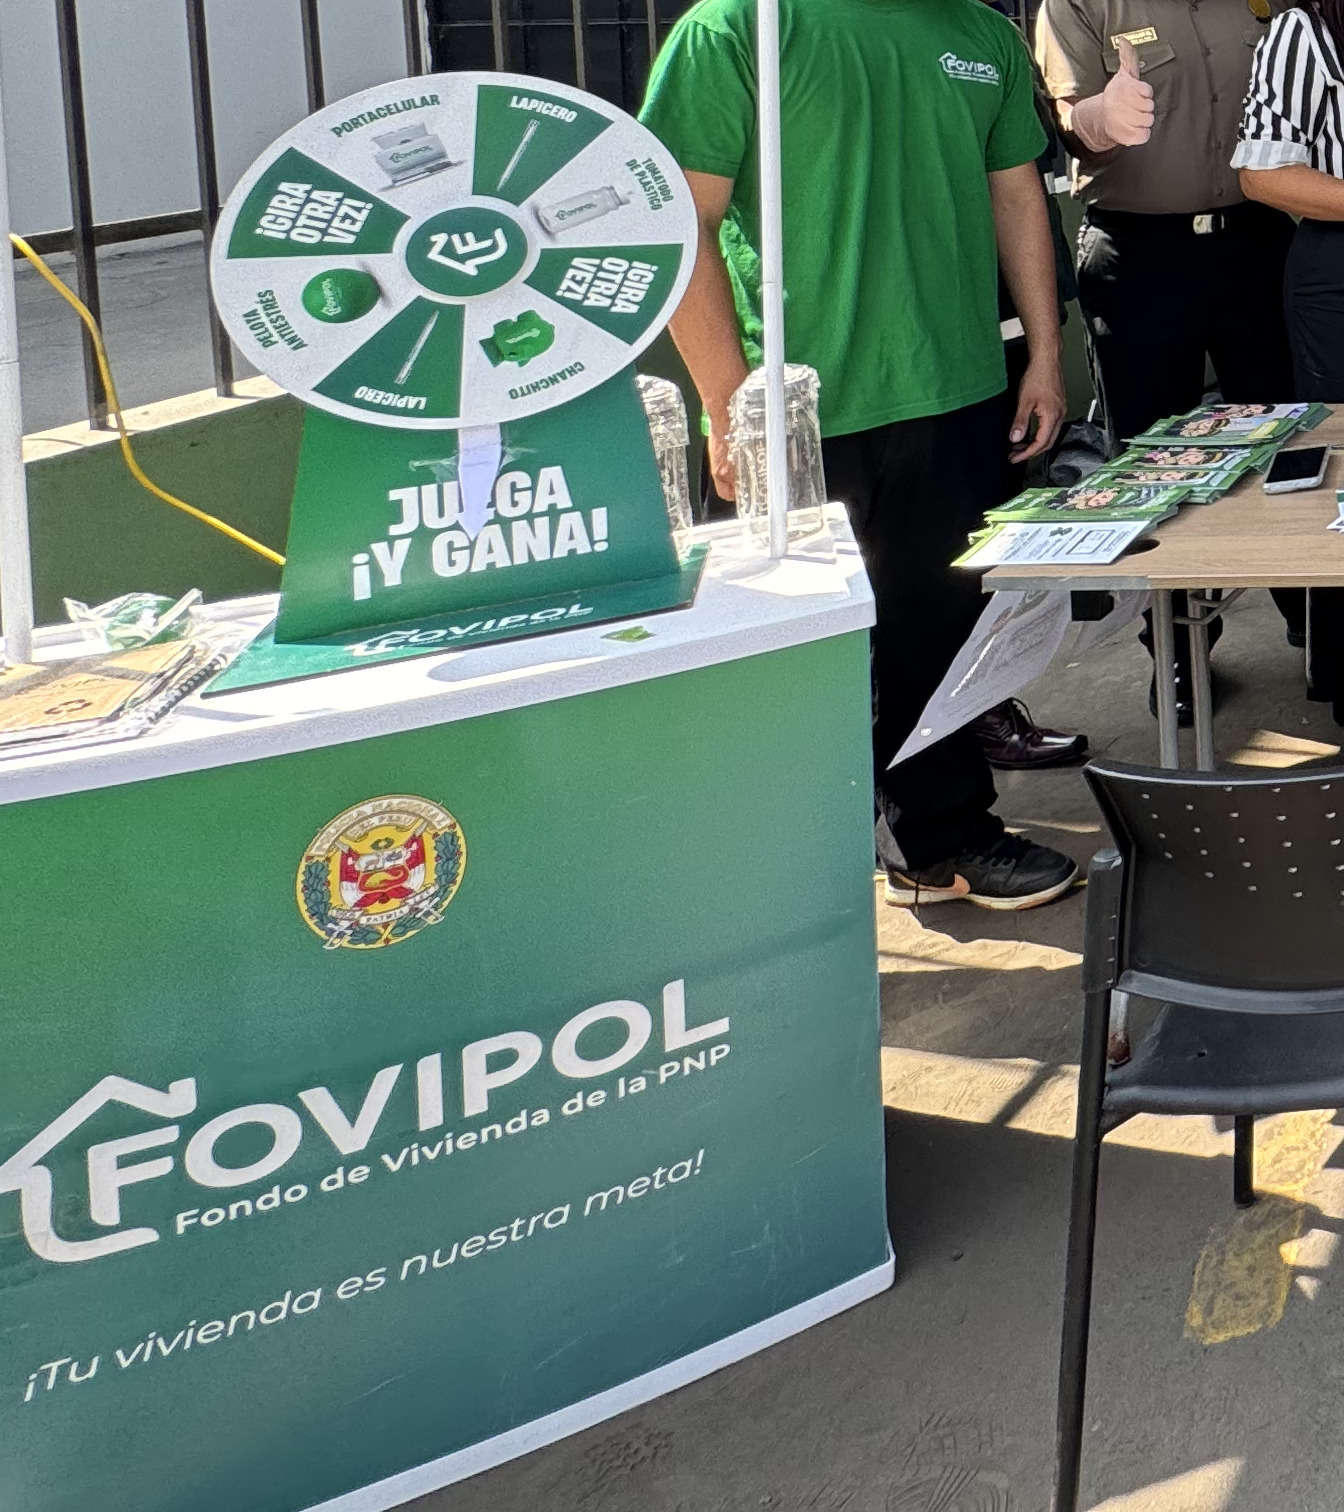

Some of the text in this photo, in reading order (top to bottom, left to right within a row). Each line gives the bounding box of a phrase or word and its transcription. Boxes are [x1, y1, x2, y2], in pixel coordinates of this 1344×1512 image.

[948, 59, 998, 77] FOVIPOL
[330, 94, 441, 138] PORTACELULAR
[509, 95, 578, 123] LAPICERO
[626, 159, 637, 171] DE
[642, 157, 674, 203] TOMATODO
[290, 190, 344, 244] OTRA
[322, 197, 374, 244] VEZ!
[555, 257, 600, 301] VEZ!
[582, 257, 630, 307] OTRA
[242, 308, 279, 349] PELOTA
[354, 385, 427, 410] LAPICERO
[508, 361, 585, 400] CHANCHITO
[389, 465, 573, 536] JUGA
[352, 506, 609, 601] ¡Y GANA!
[385, 603, 594, 649] FOVIPOL
[86, 978, 730, 1228] FOVIPOL
[174, 1042, 732, 1235] Fondo de Vivienda de la PNP
[22, 1148, 707, 1403] ¡Tu vivienda es nuestra meta!
